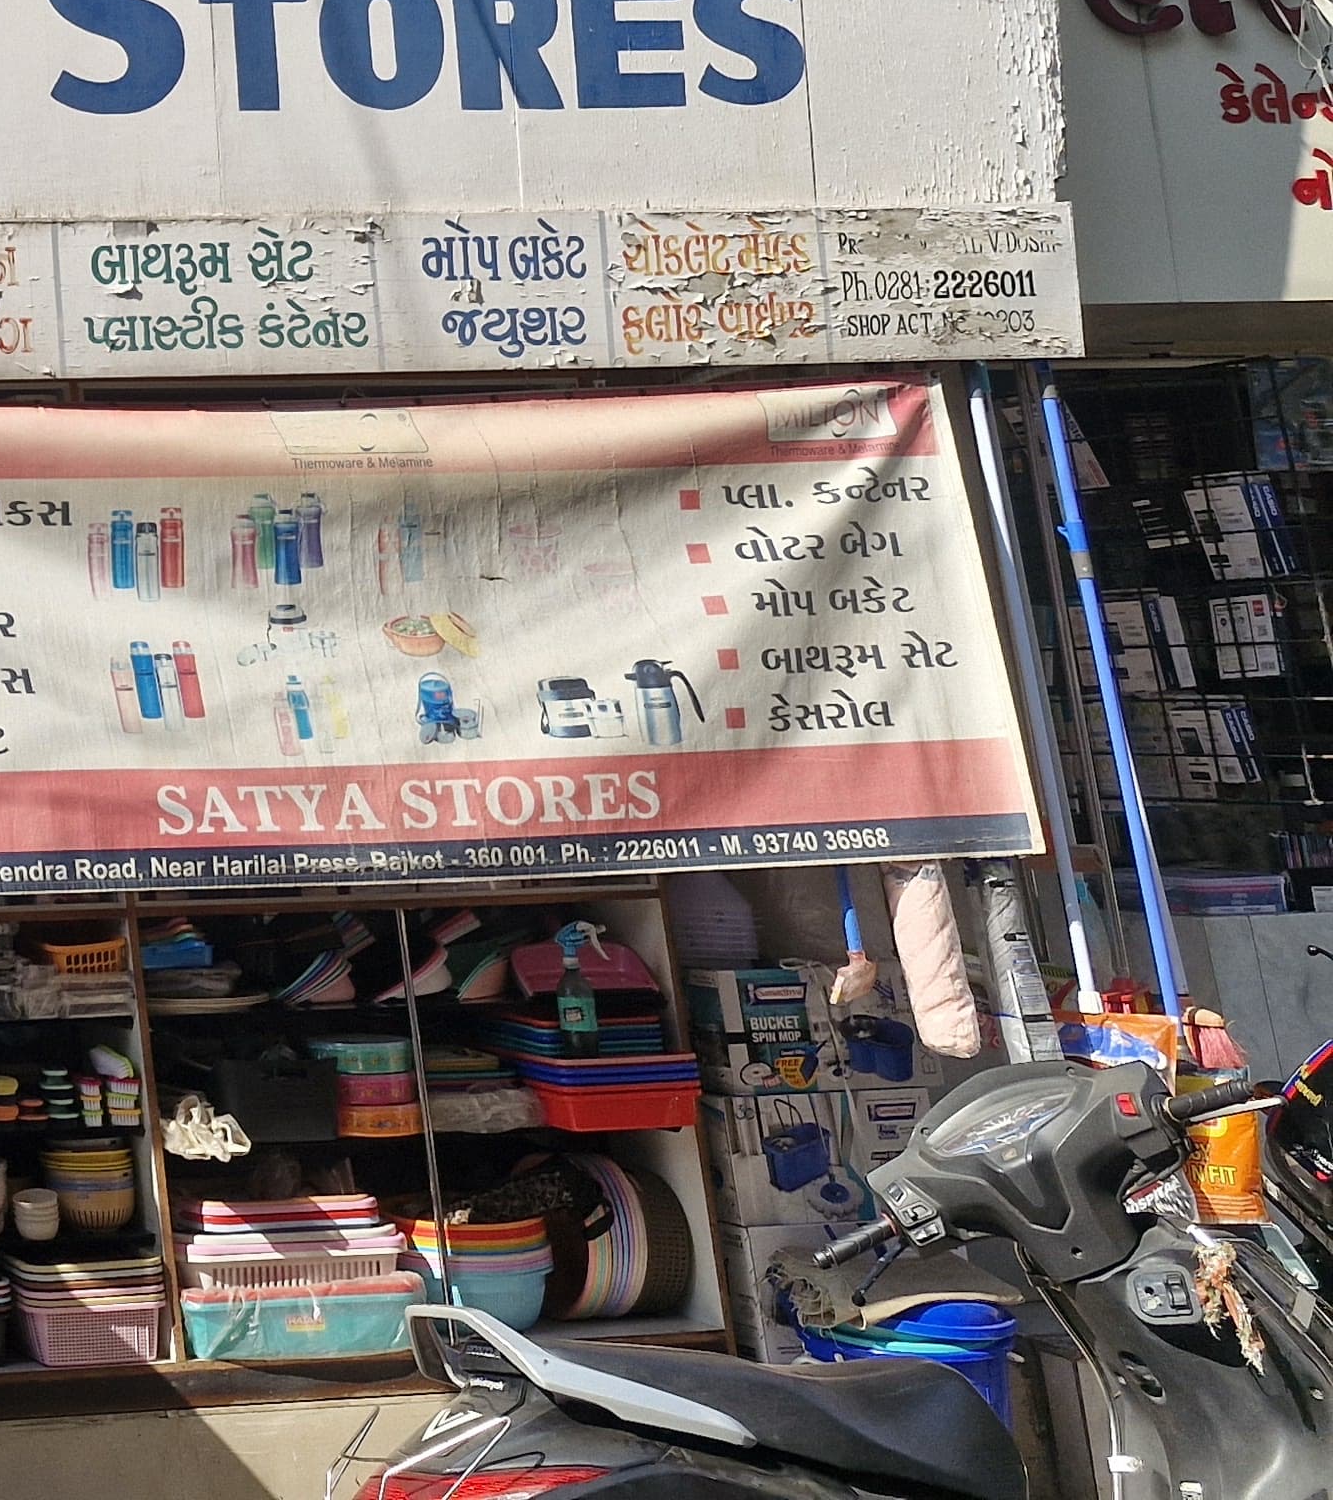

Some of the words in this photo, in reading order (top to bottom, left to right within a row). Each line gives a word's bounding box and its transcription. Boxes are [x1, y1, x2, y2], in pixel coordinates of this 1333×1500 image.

[91, 241, 231, 295] બાથરૂમ
[248, 228, 313, 282] સેટ
[422, 220, 497, 281] મોપ
[509, 218, 586, 281] બકેટ
[933, 269, 1036, 298] 2226011
[847, 314, 890, 336] SHOP
[896, 313, 932, 335] ACT
[292, 456, 364, 470] Thermoware
[378, 455, 433, 469] Melamine
[722, 481, 795, 511] પ્લા.
[812, 467, 932, 503] કન્ટેનર
[735, 526, 826, 563] વોટર
[839, 521, 904, 559] બેગ
[751, 580, 816, 617] મોપ
[828, 576, 916, 615] બકેટ
[761, 643, 886, 680] બાથરૂમ
[900, 631, 960, 669] સેટ
[767, 689, 895, 734] કેસરોલ
[157, 784, 387, 835] SATYA
[399, 770, 662, 831] STORES
[74, 856, 144, 881] Road,
[150, 853, 206, 879] Near
[212, 851, 288, 876] Harilal
[292, 850, 366, 876] Press,
[370, 848, 445, 876] Rajkot
[464, 846, 504, 869] 360
[508, 843, 555, 867] 001.
[560, 842, 596, 864] Ph.
[614, 832, 702, 861] 2226011
[721, 834, 748, 857] M.
[752, 829, 820, 855] 93740
[823, 826, 889, 852] 36968
[750, 1015, 799, 1031] BUCKET
[752, 1031, 777, 1043] SPIN
[779, 1031, 801, 1042] MOP
[1208, 1165, 1237, 1185] FIT
